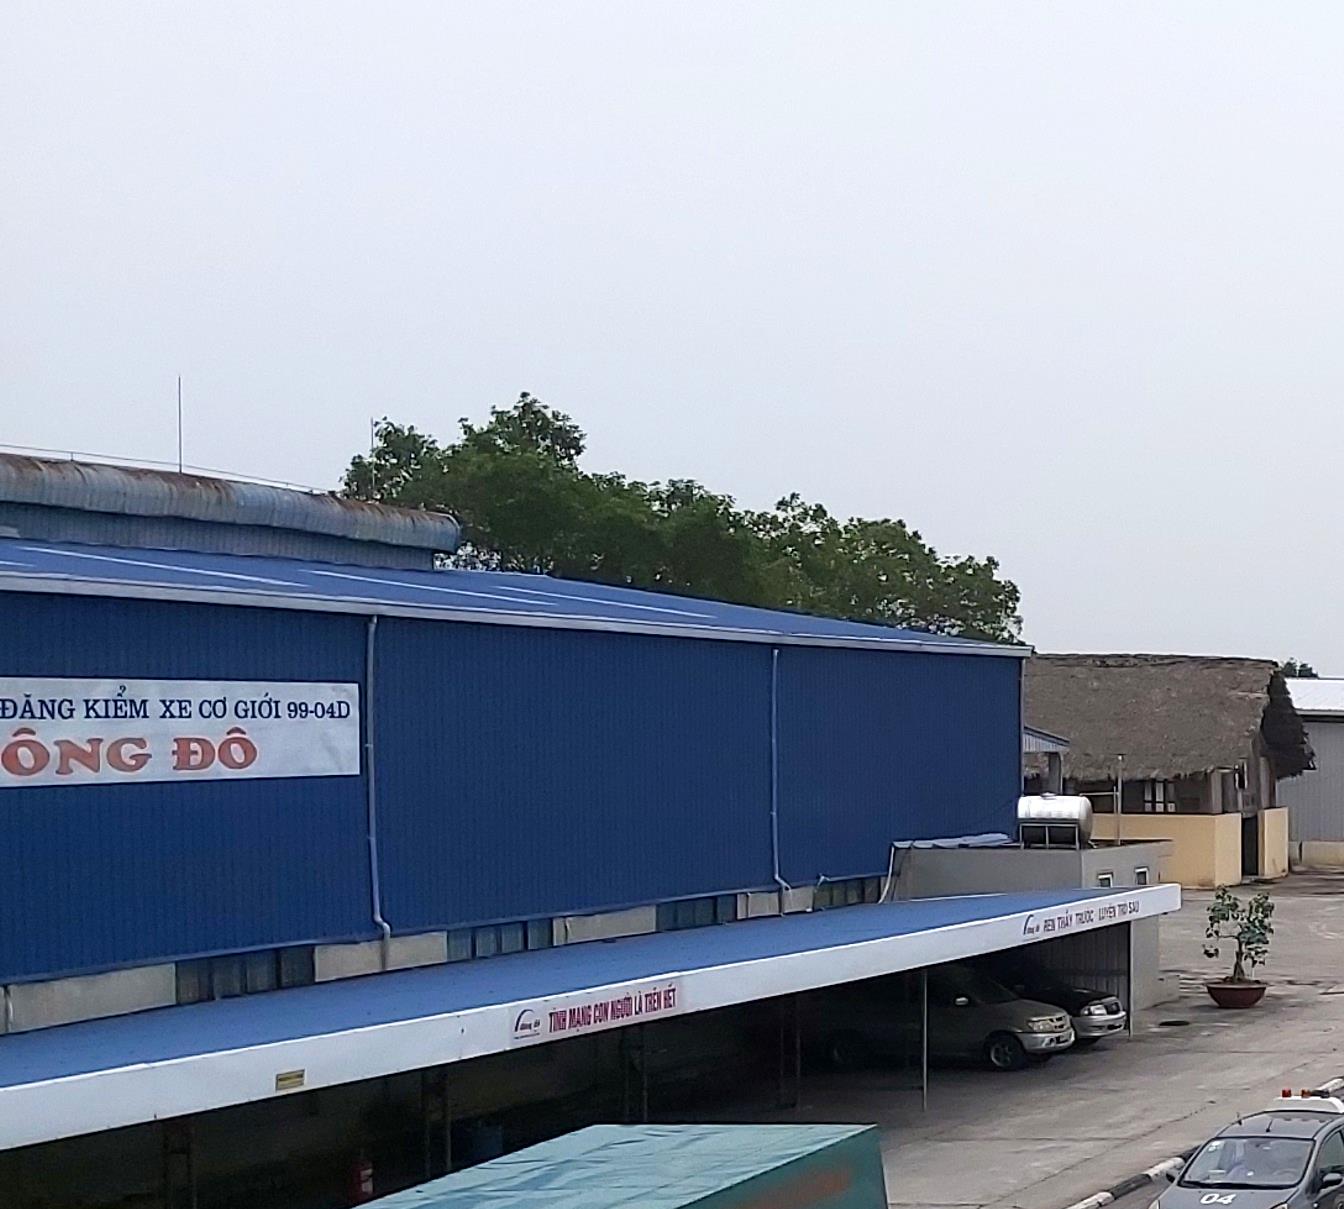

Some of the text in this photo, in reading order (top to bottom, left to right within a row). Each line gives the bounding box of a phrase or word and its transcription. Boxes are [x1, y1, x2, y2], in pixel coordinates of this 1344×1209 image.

[0, 685, 350, 720] ĐĂNG KIỂM XE CƠ GIỚI 99-04D
[172, 726, 258, 772] ĐÔ
[1200, 1193, 1237, 1206] 04
